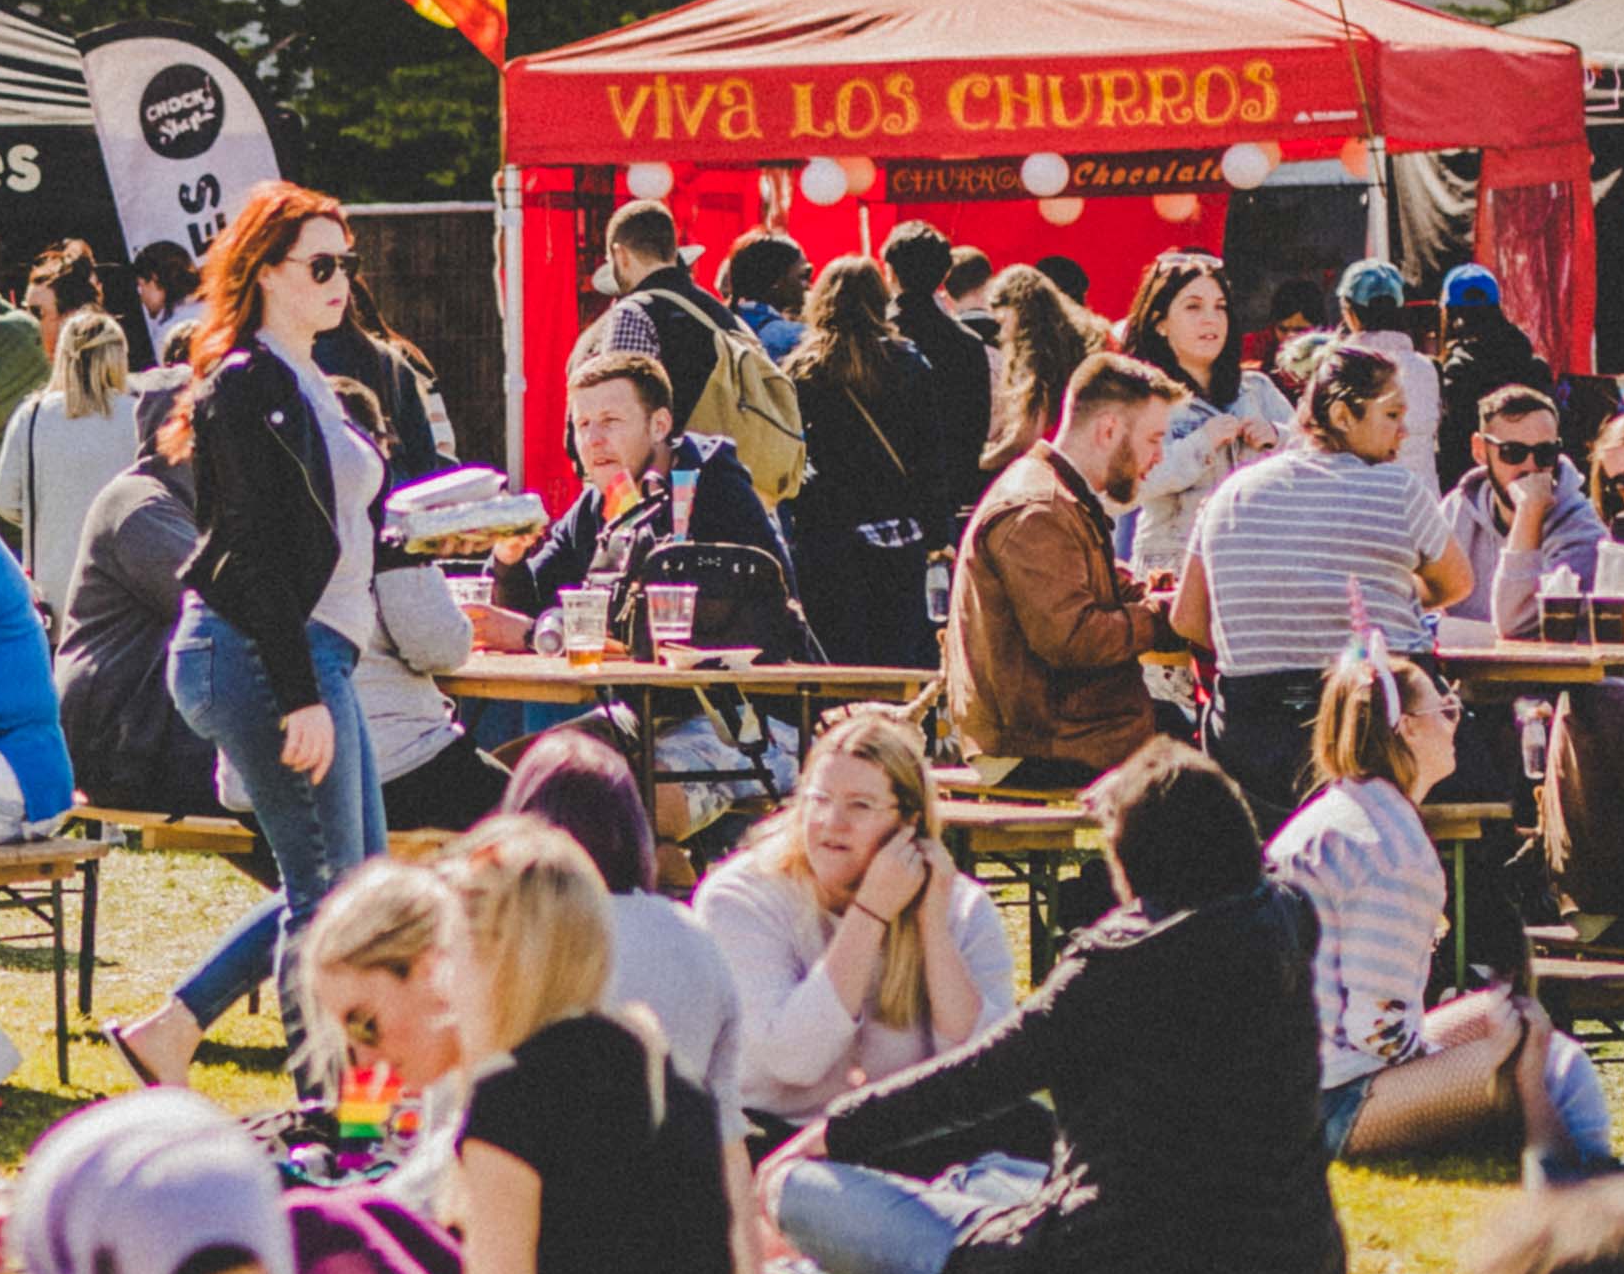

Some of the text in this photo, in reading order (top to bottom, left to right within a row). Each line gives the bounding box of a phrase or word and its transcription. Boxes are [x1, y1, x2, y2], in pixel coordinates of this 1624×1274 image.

[145, 87, 206, 123] CHOCK
[789, 72, 920, 140] LOS
[947, 58, 1280, 131] CHURROS
[892, 165, 1027, 194] CHURRO
